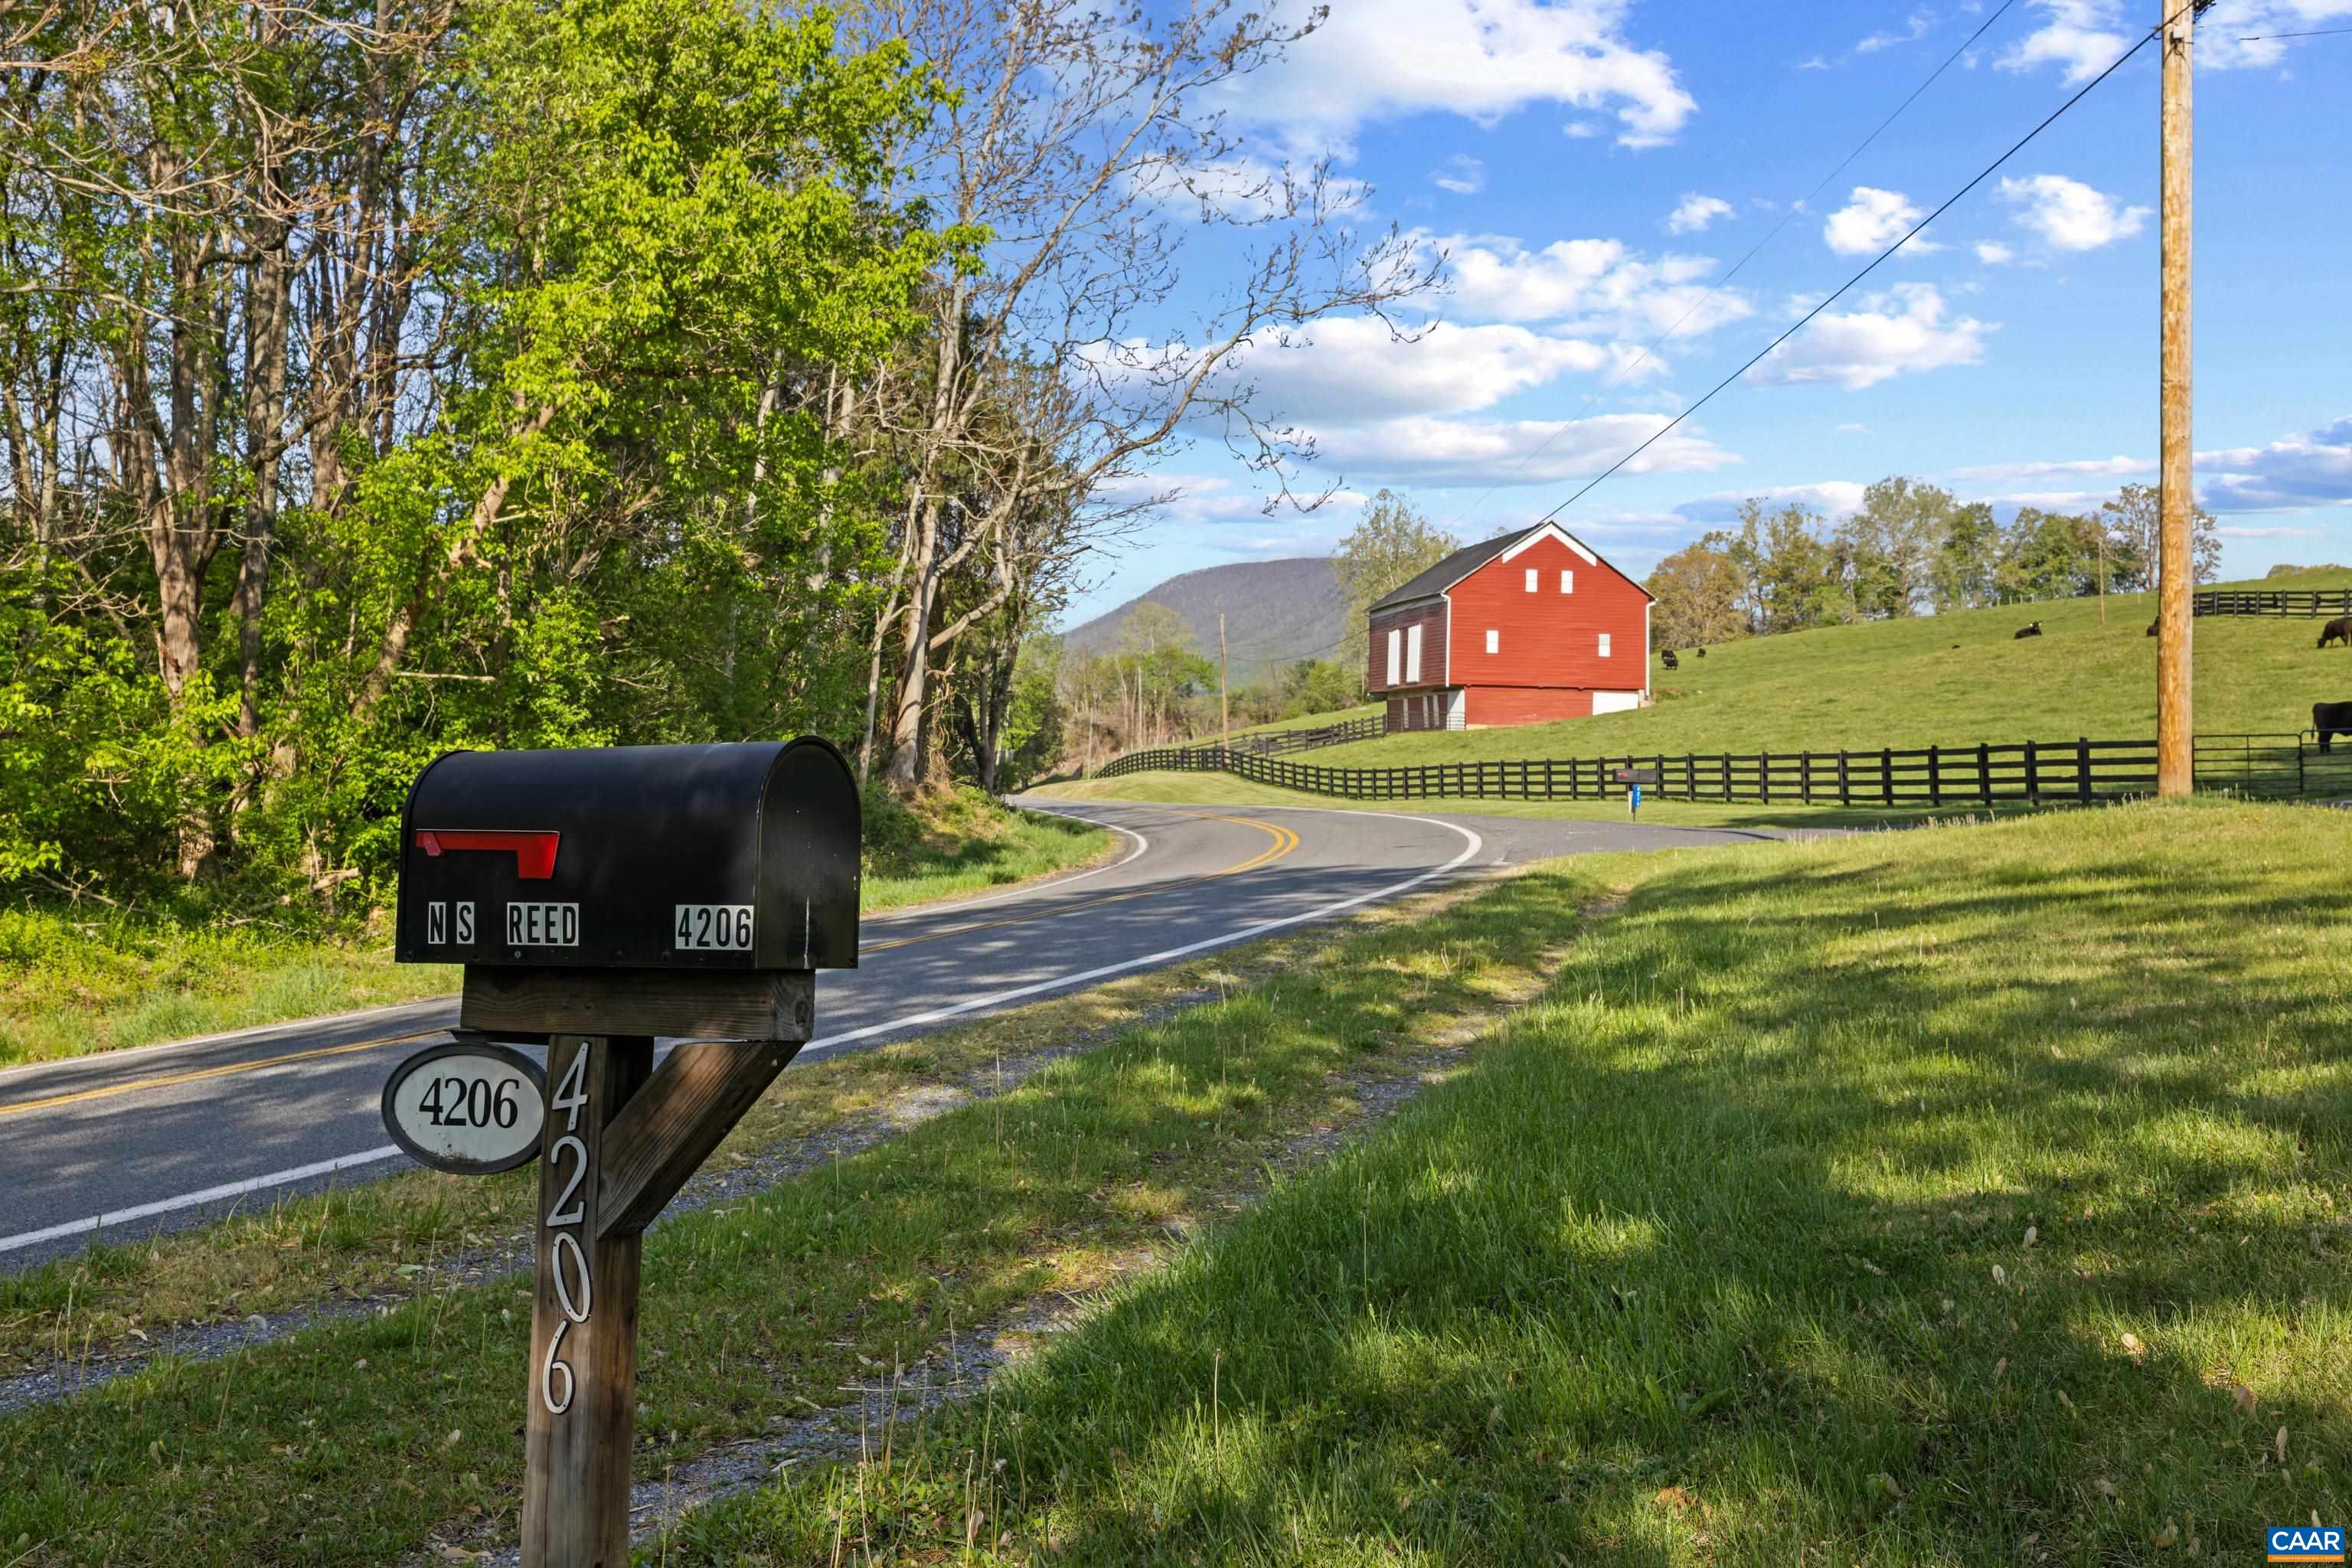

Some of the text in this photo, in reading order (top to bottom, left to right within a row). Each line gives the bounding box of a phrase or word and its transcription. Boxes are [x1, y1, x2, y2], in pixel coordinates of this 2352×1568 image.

[430, 904, 576, 944] N S REED
[678, 907, 751, 948] 4206
[419, 1077, 520, 1129] 4206
[542, 1041, 591, 1414] 4206
